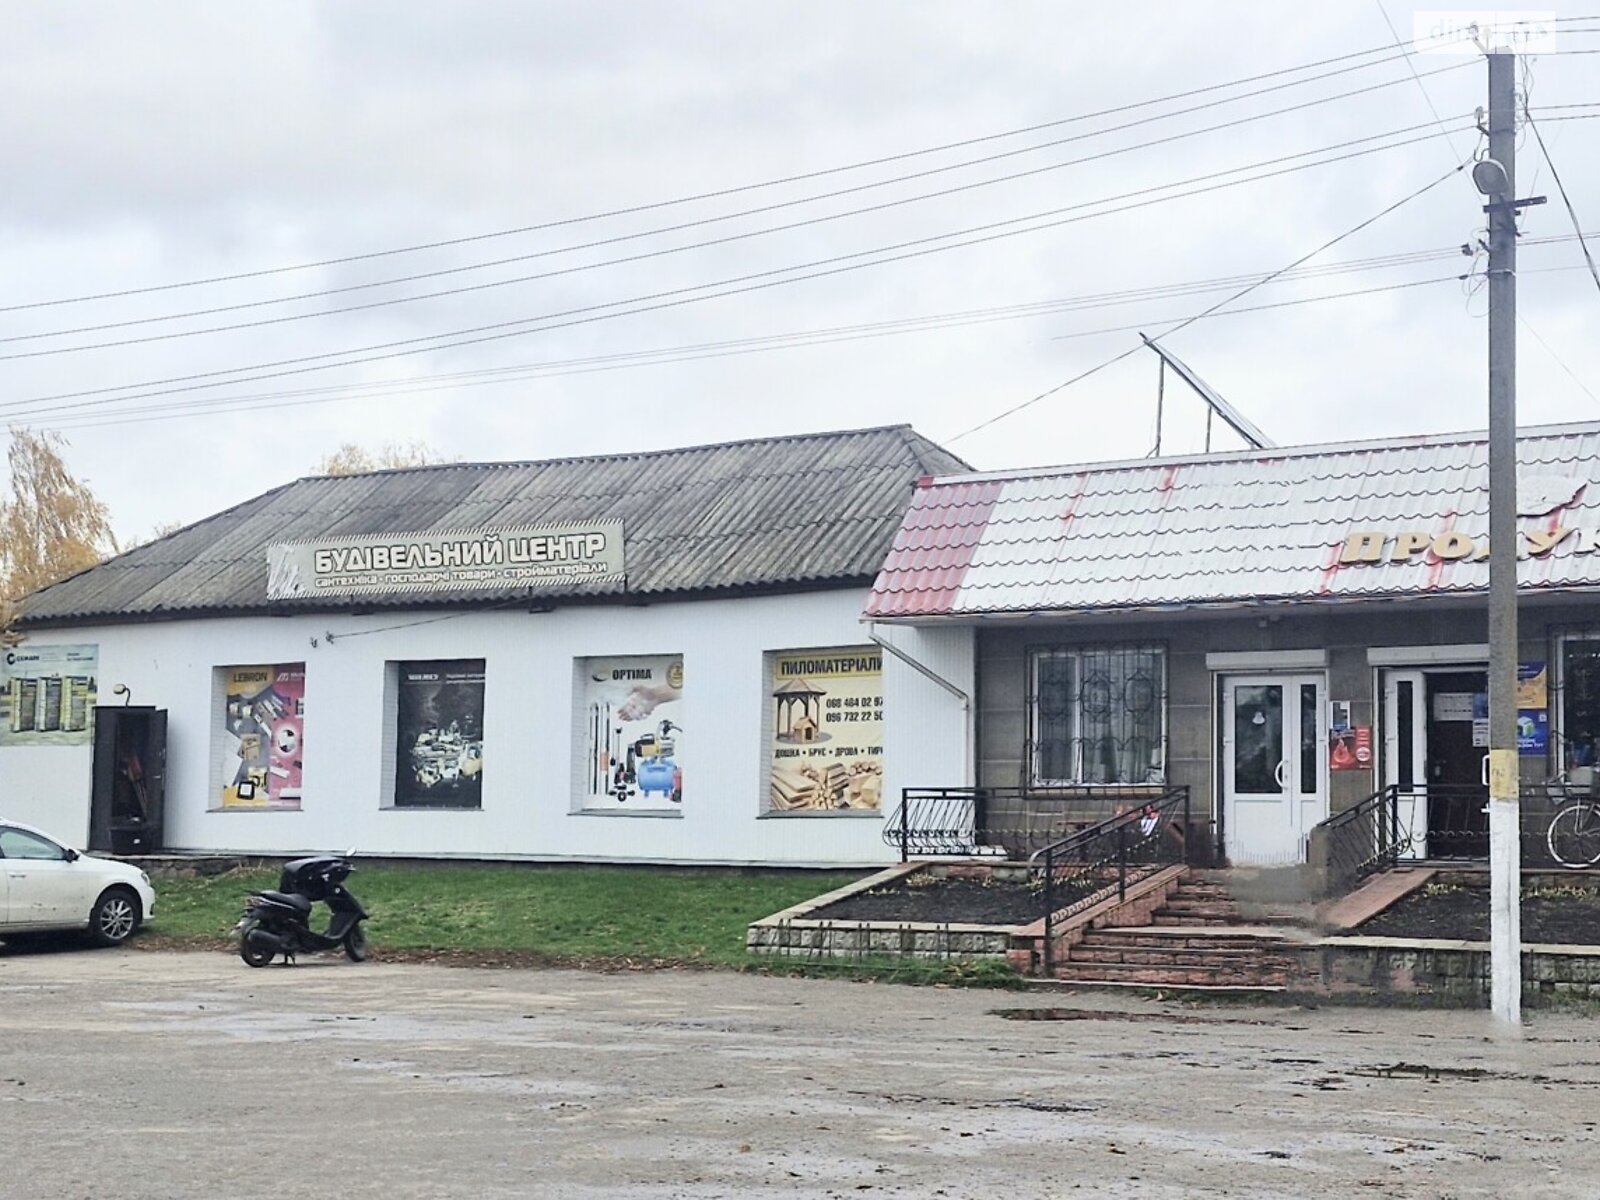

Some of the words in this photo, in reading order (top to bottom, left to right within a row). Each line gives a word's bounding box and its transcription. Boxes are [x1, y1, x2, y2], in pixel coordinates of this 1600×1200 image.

[314, 535, 503, 573] БУДІВЕЛЬНИЙ
[508, 533, 606, 562] ЦЕНТР
[385, 570, 449, 585] господарчі
[453, 570, 496, 583] товари
[503, 562, 607, 580] стройматеріали
[233, 671, 268, 683] LEBRON
[612, 668, 652, 680] OPTIMA
[861, 697, 872, 707] 02
[861, 711, 872, 721] 22
[774, 748, 800, 759] ДОШКА
[808, 747, 826, 757] БРУС
[834, 746, 858, 757] ДРОВА
